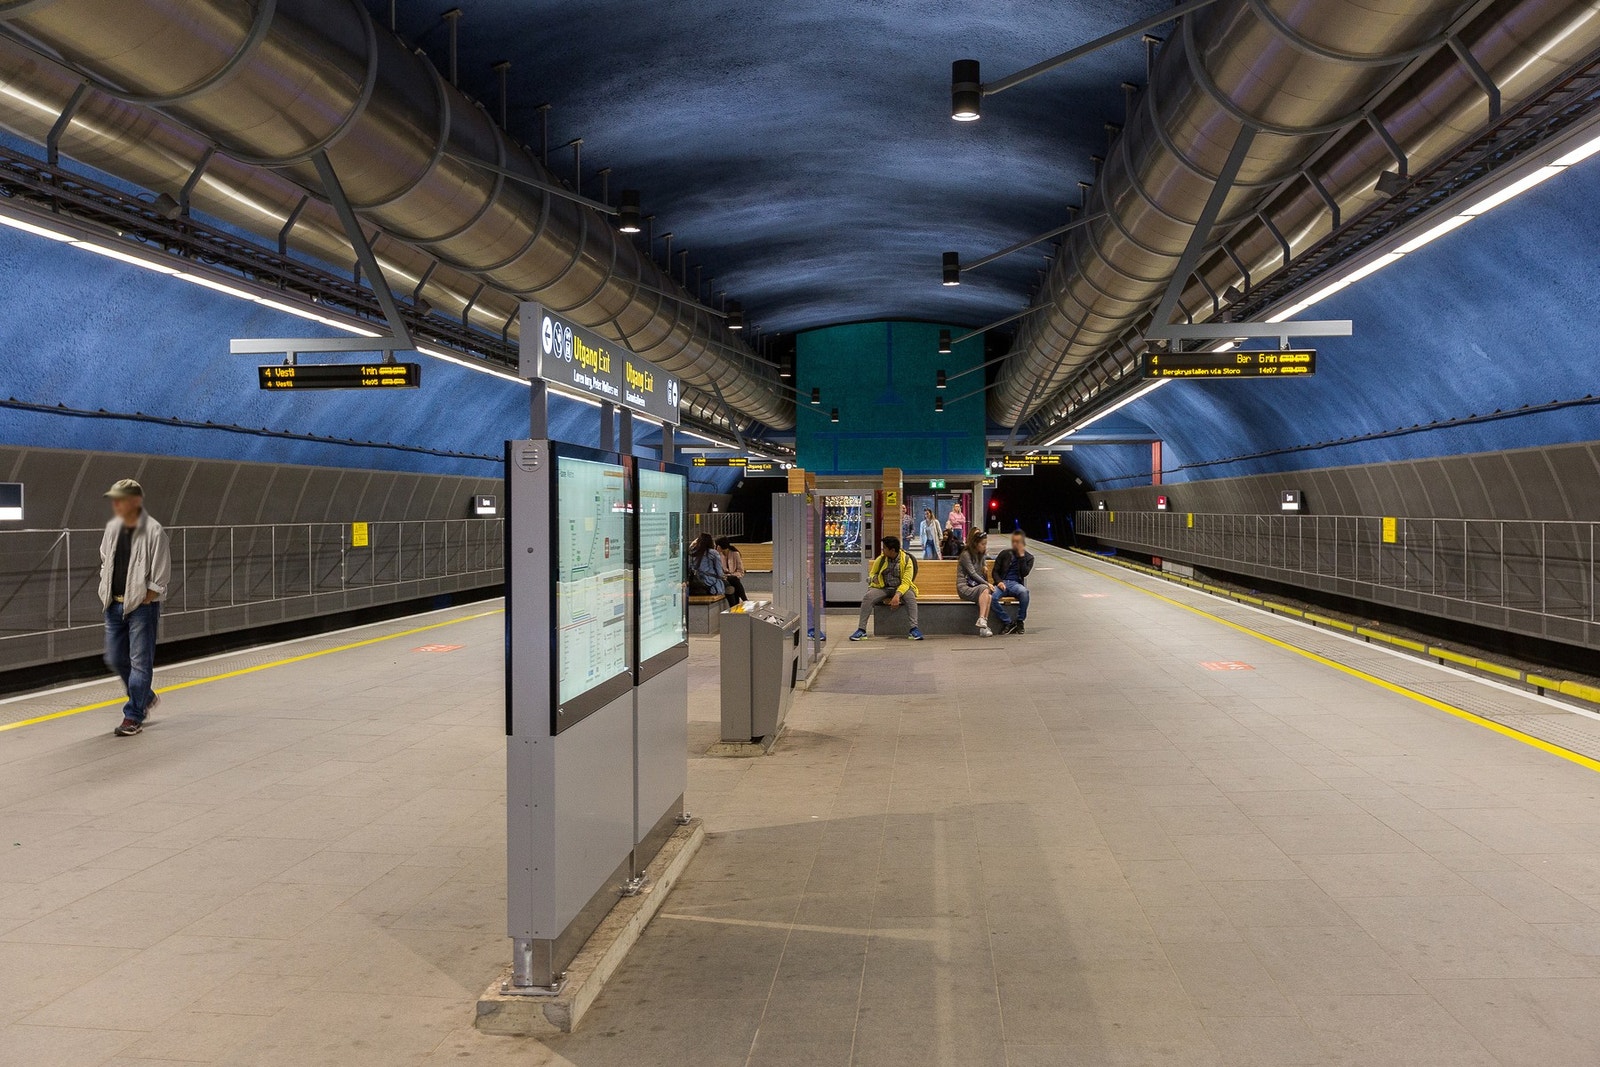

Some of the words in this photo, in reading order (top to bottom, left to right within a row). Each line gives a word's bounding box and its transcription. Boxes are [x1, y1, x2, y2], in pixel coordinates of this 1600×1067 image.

[574, 335, 598, 373] Utgang
[598, 347, 611, 374] Exit
[1152, 355, 1158, 365] 4
[1259, 354, 1264, 363] 6
[1265, 354, 1278, 363] min
[265, 368, 271, 377] 4
[361, 366, 366, 375] 1
[366, 366, 378, 375] min
[625, 361, 644, 393] Utgang
[644, 370, 654, 393] Exit
